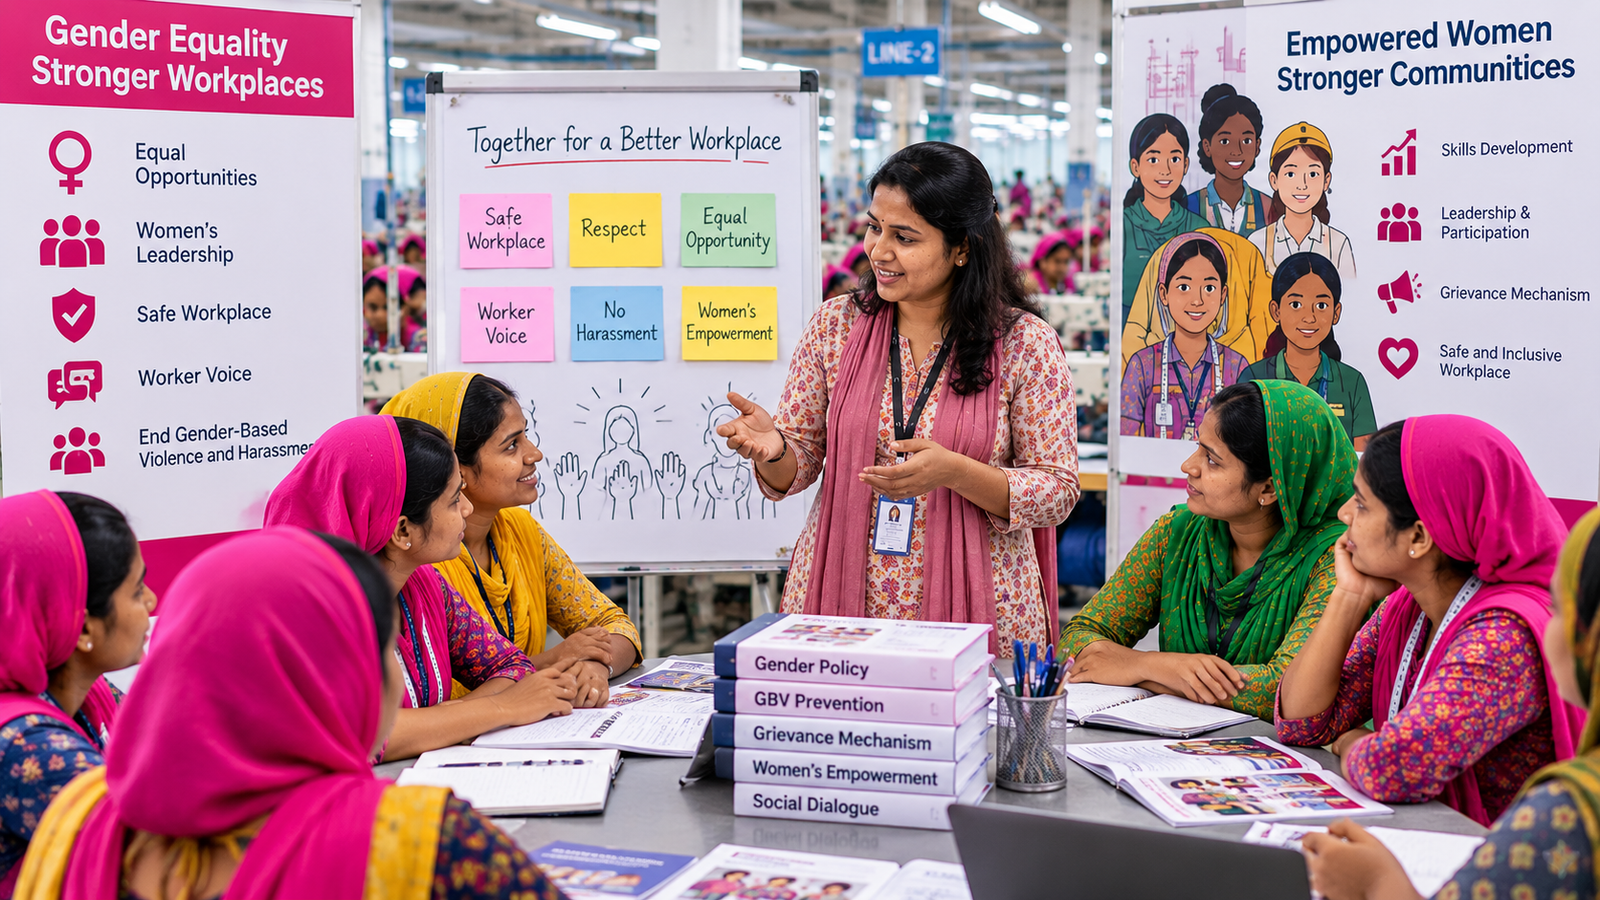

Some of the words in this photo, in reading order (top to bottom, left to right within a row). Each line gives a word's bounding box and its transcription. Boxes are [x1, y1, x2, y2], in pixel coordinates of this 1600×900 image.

[46, 15, 160, 50] Gender
[170, 24, 288, 66] Equality
[1287, 21, 1438, 61] Empowered
[1447, 20, 1551, 47] Women
[868, 42, 934, 64] LINE-2
[32, 55, 159, 95] Stronger
[167, 63, 324, 101] Workplaces
[1278, 67, 1383, 95] Stronger
[1391, 53, 1575, 86] Communitices
[135, 142, 186, 164] Equal
[467, 125, 556, 164] Together
[563, 125, 592, 152] for
[601, 137, 612, 150] a
[620, 126, 681, 151] Better
[689, 126, 781, 159] Workplace
[1442, 142, 1476, 156] Skills
[1481, 140, 1573, 157] Development
[136, 167, 257, 189] Opportunities
[485, 207, 522, 226] Safe
[704, 206, 747, 231] Equal
[1442, 206, 1516, 222] Leadership
[1521, 206, 1530, 219] &
[582, 218, 646, 243] Respect
[1442, 225, 1529, 242] Participation
[467, 232, 545, 256] Workplace
[686, 231, 771, 255] Opportunity
[138, 245, 233, 266] Leadership
[1441, 286, 1507, 300] Grievance
[1512, 287, 1589, 301] Mechanism
[138, 305, 175, 322] Safe
[182, 303, 271, 324] Workplace
[478, 302, 535, 320] Worker
[605, 300, 625, 318] No
[486, 327, 527, 344] Voice
[577, 324, 658, 341] Harassment
[687, 324, 773, 346] Empowerment
[1440, 345, 1469, 358] Safe
[1473, 346, 1497, 359] and
[1503, 347, 1561, 362] Inclusive
[138, 368, 201, 386] Worker
[206, 366, 251, 382] Voice
[1440, 363, 1510, 380] Workplace
[140, 427, 169, 445] End
[175, 419, 288, 442] Gender-Based
[139, 451, 203, 467] Violence
[208, 449, 233, 462] and
[755, 656, 815, 673] Gender
[820, 659, 869, 680] Policy
[755, 691, 790, 706] GBV
[795, 694, 883, 712] Prevention
[754, 726, 834, 744] Grievance
[839, 731, 931, 750] Mechanism
[827, 765, 938, 786] Empowerment
[753, 794, 801, 810] Social
[808, 797, 879, 818] Dialogue
